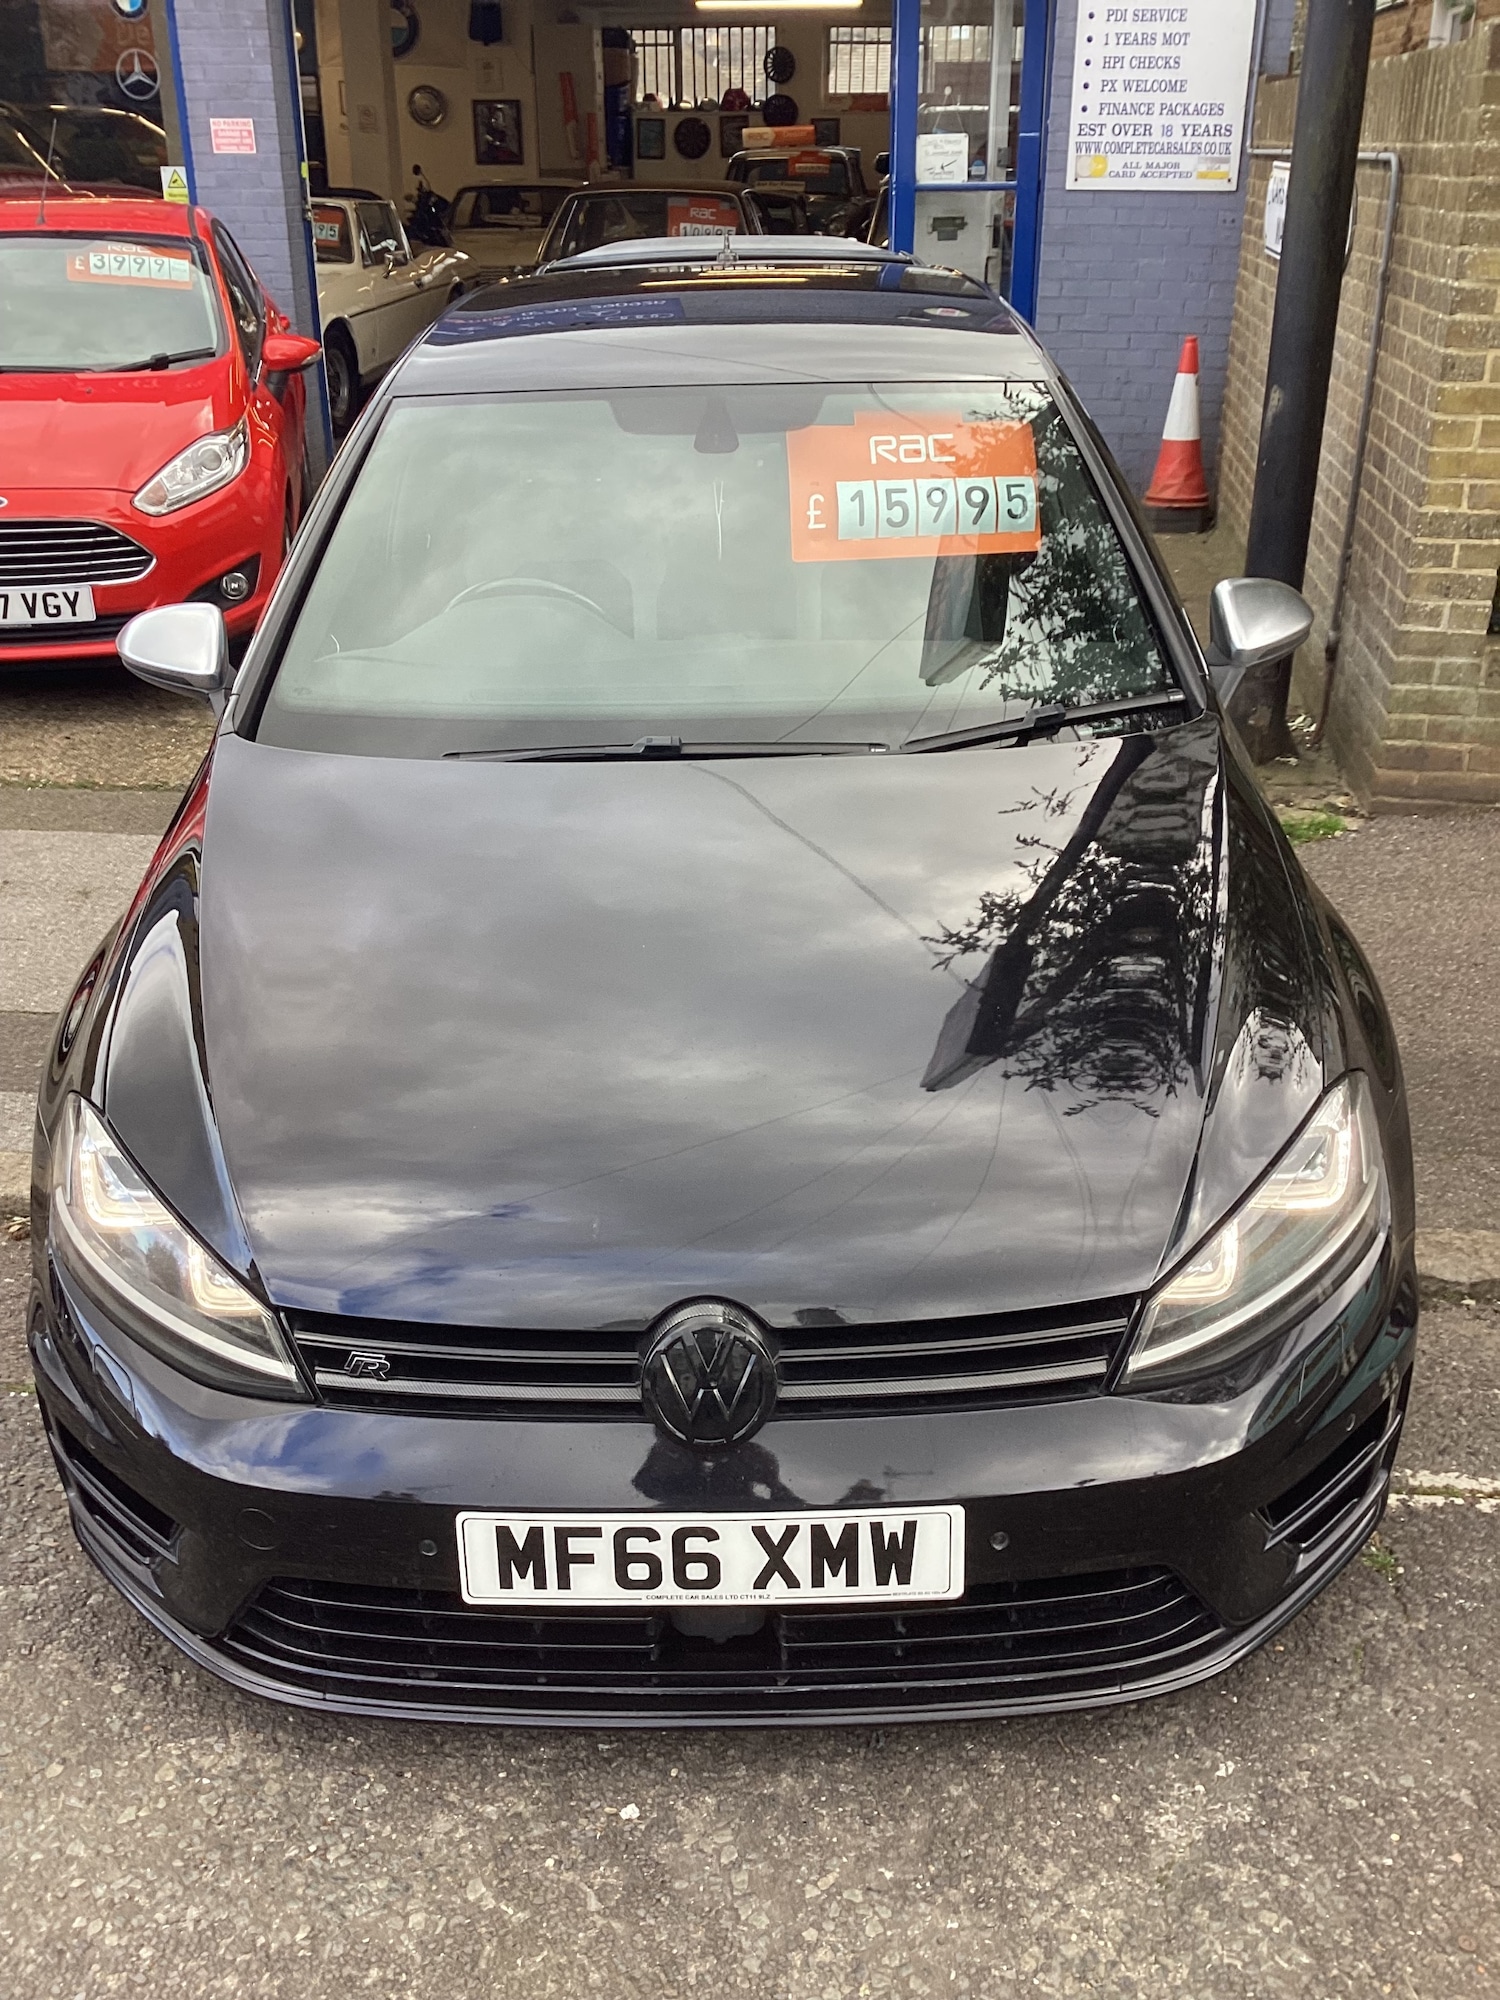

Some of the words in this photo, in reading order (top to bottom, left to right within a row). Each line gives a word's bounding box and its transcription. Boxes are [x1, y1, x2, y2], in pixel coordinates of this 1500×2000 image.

[1106, 8, 1128, 23] PDI
[1132, 8, 1188, 23] SERVICE
[1104, 32, 1110, 46] 1
[1114, 32, 1157, 46] YEARS
[1161, 32, 1190, 46] MOT
[1102, 56, 1125, 70] HPI
[1129, 56, 1181, 70] CHECKS
[1100, 79, 1118, 93] PX
[1123, 79, 1188, 93] WELCOME
[1098, 102, 1155, 116] FINANCE
[1159, 102, 1225, 116] PACKAGES
[1077, 123, 1106, 137] EST
[1112, 123, 1153, 137] OVER
[1161, 124, 1174, 138] 18
[1181, 123, 1233, 138] YEARS
[1075, 141, 1232, 155] WWW.COMPLETECARSALES.CO.UK
[1122, 161, 1142, 170] ALL
[1145, 161, 1181, 170] MAJOR
[1108, 170, 1136, 179] CARD
[1140, 170, 1193, 179] ACCEPTED
[93, 254, 165, 273] 3999
[807, 493, 826, 529] £
[850, 484, 1029, 528] 15995
[20, 591, 79, 618] VGY
[494, 1525, 722, 1591] MF66
[750, 1519, 919, 1590] XMW
